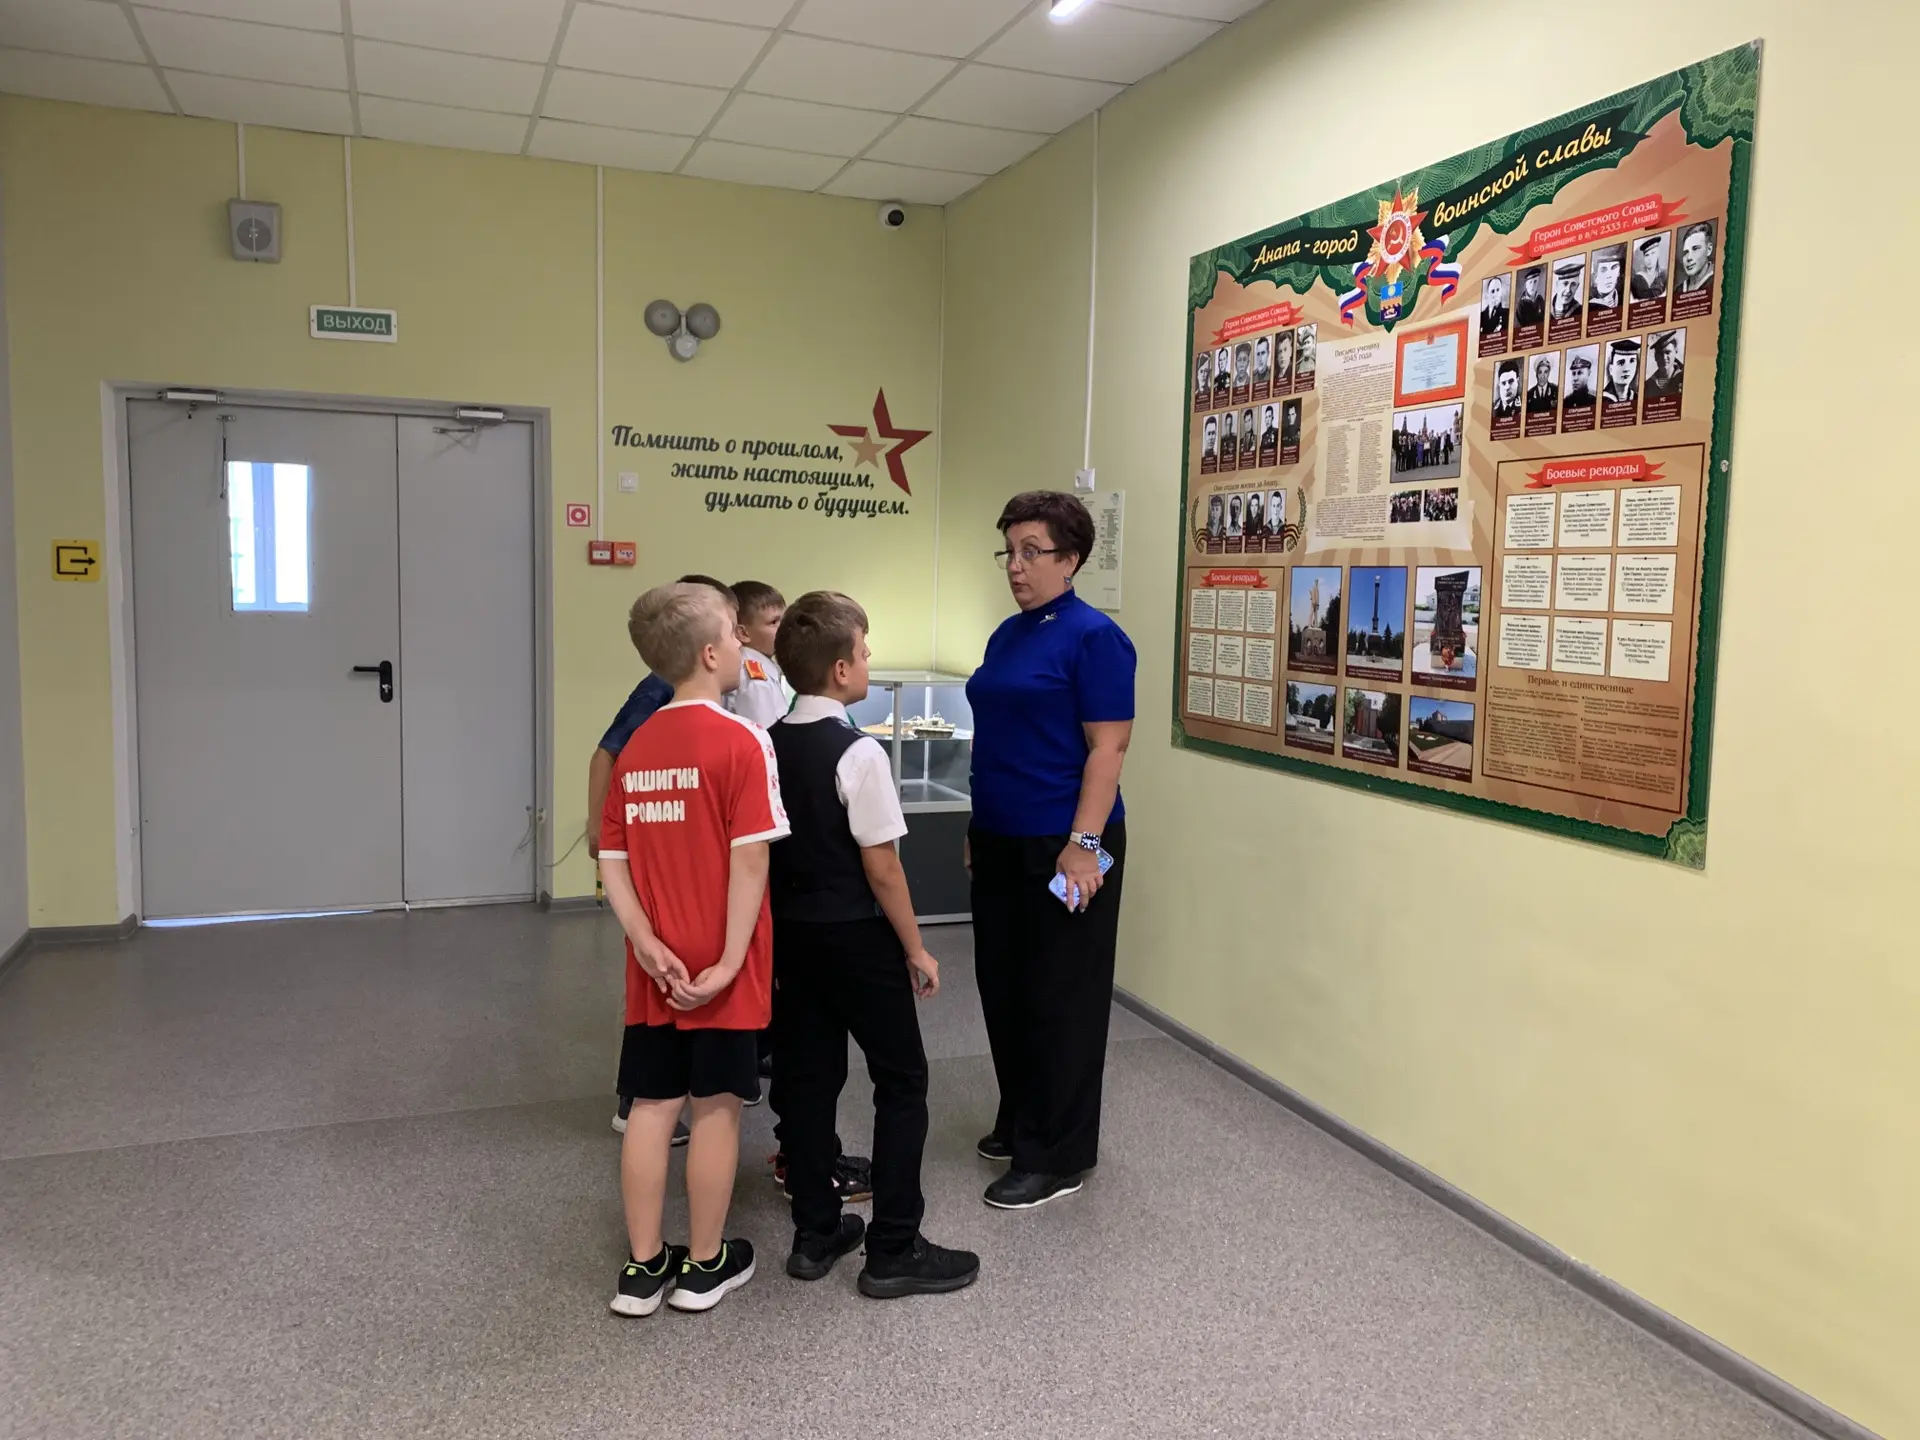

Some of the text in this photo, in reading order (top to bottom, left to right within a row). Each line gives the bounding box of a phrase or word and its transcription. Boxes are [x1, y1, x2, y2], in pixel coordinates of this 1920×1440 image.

[1251, 239, 1301, 273] Анапа
[1312, 230, 1359, 259] город
[1432, 156, 1529, 228] воинской
[1535, 123, 1612, 170] славы
[1563, 210, 1620, 234] Советского
[323, 314, 387, 333] ВЫХОД
[611, 424, 844, 462] Помнить о прошлом,
[671, 461, 875, 490] жить настоящим,
[1546, 463, 1639, 480] Боевые рекорды
[704, 490, 910, 518] думать о будущем.
[1527, 675, 1560, 687] Первые
[621, 767, 699, 793] ИШИГИН
[625, 800, 685, 825] РОМАН
